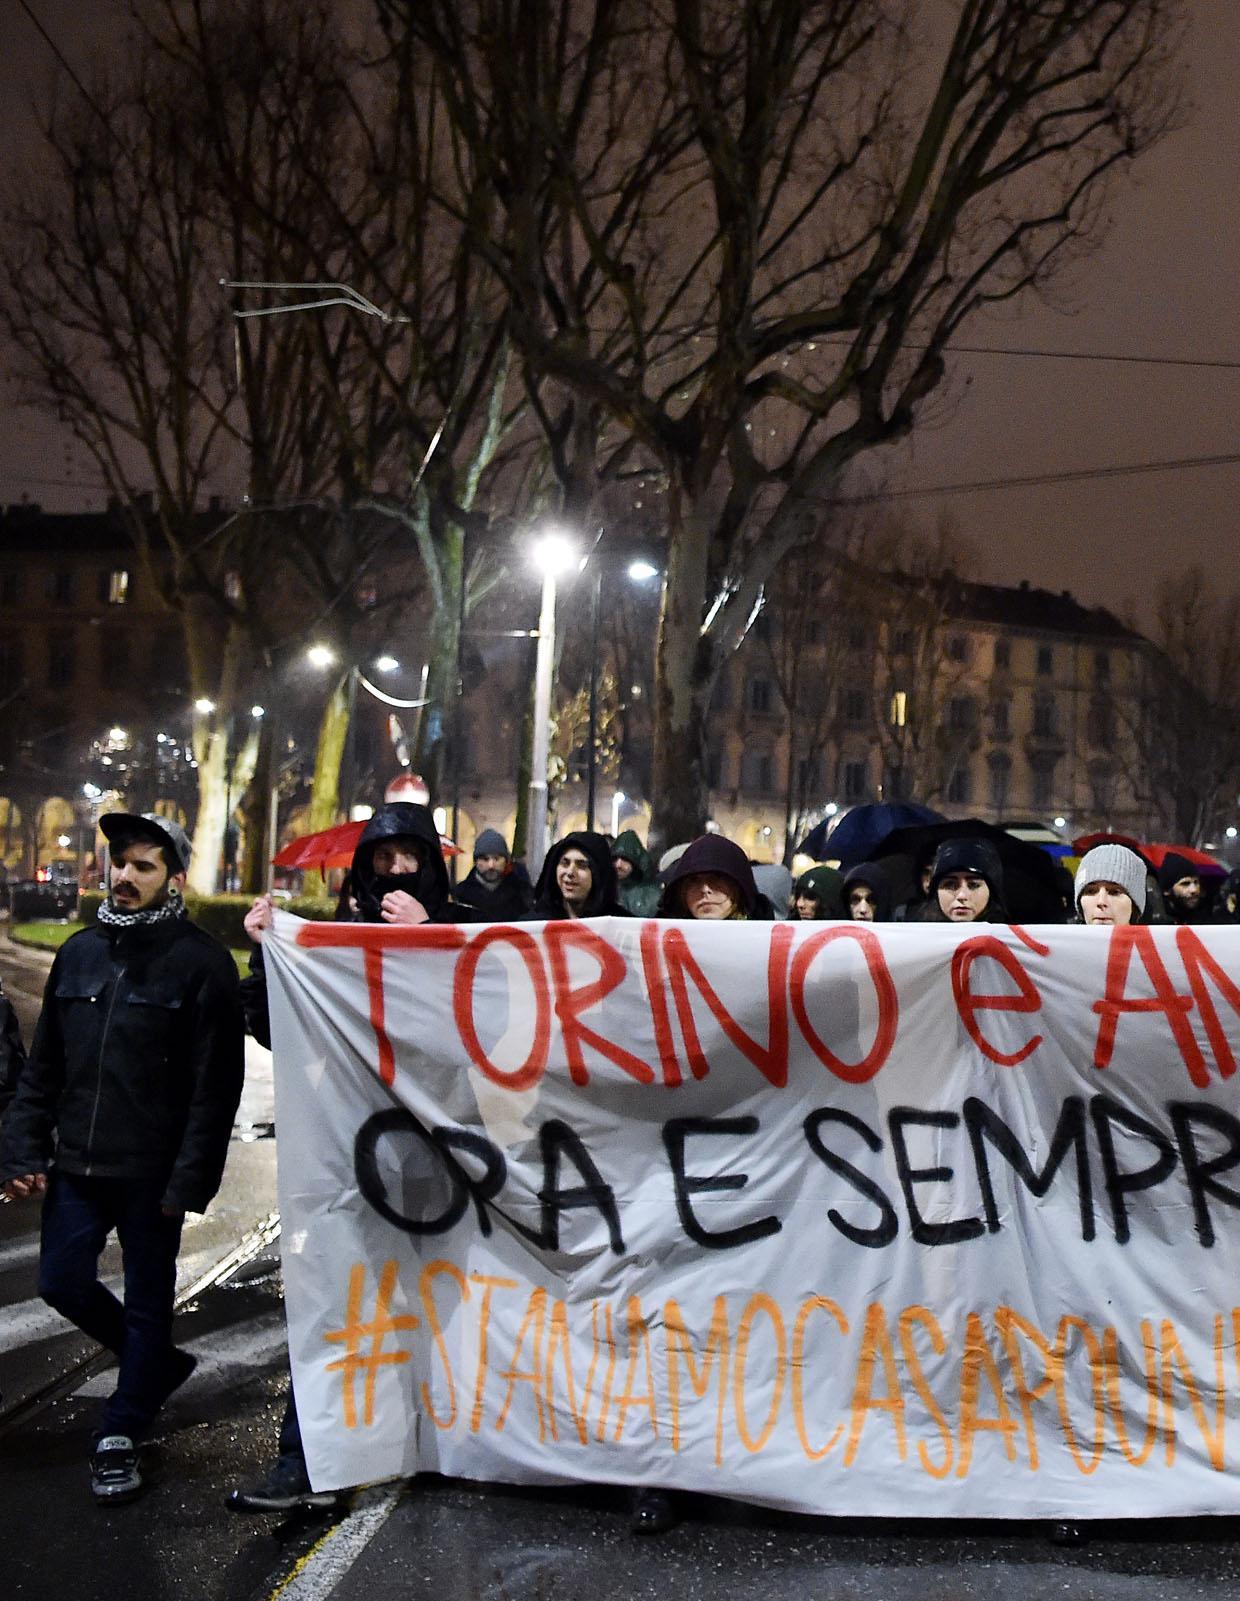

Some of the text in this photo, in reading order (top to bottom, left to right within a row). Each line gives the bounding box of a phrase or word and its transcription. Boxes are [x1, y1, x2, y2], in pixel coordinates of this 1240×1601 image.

[298, 920, 899, 1092] TORINO
[355, 1108, 627, 1255] ORA
[660, 1116, 782, 1250] E
